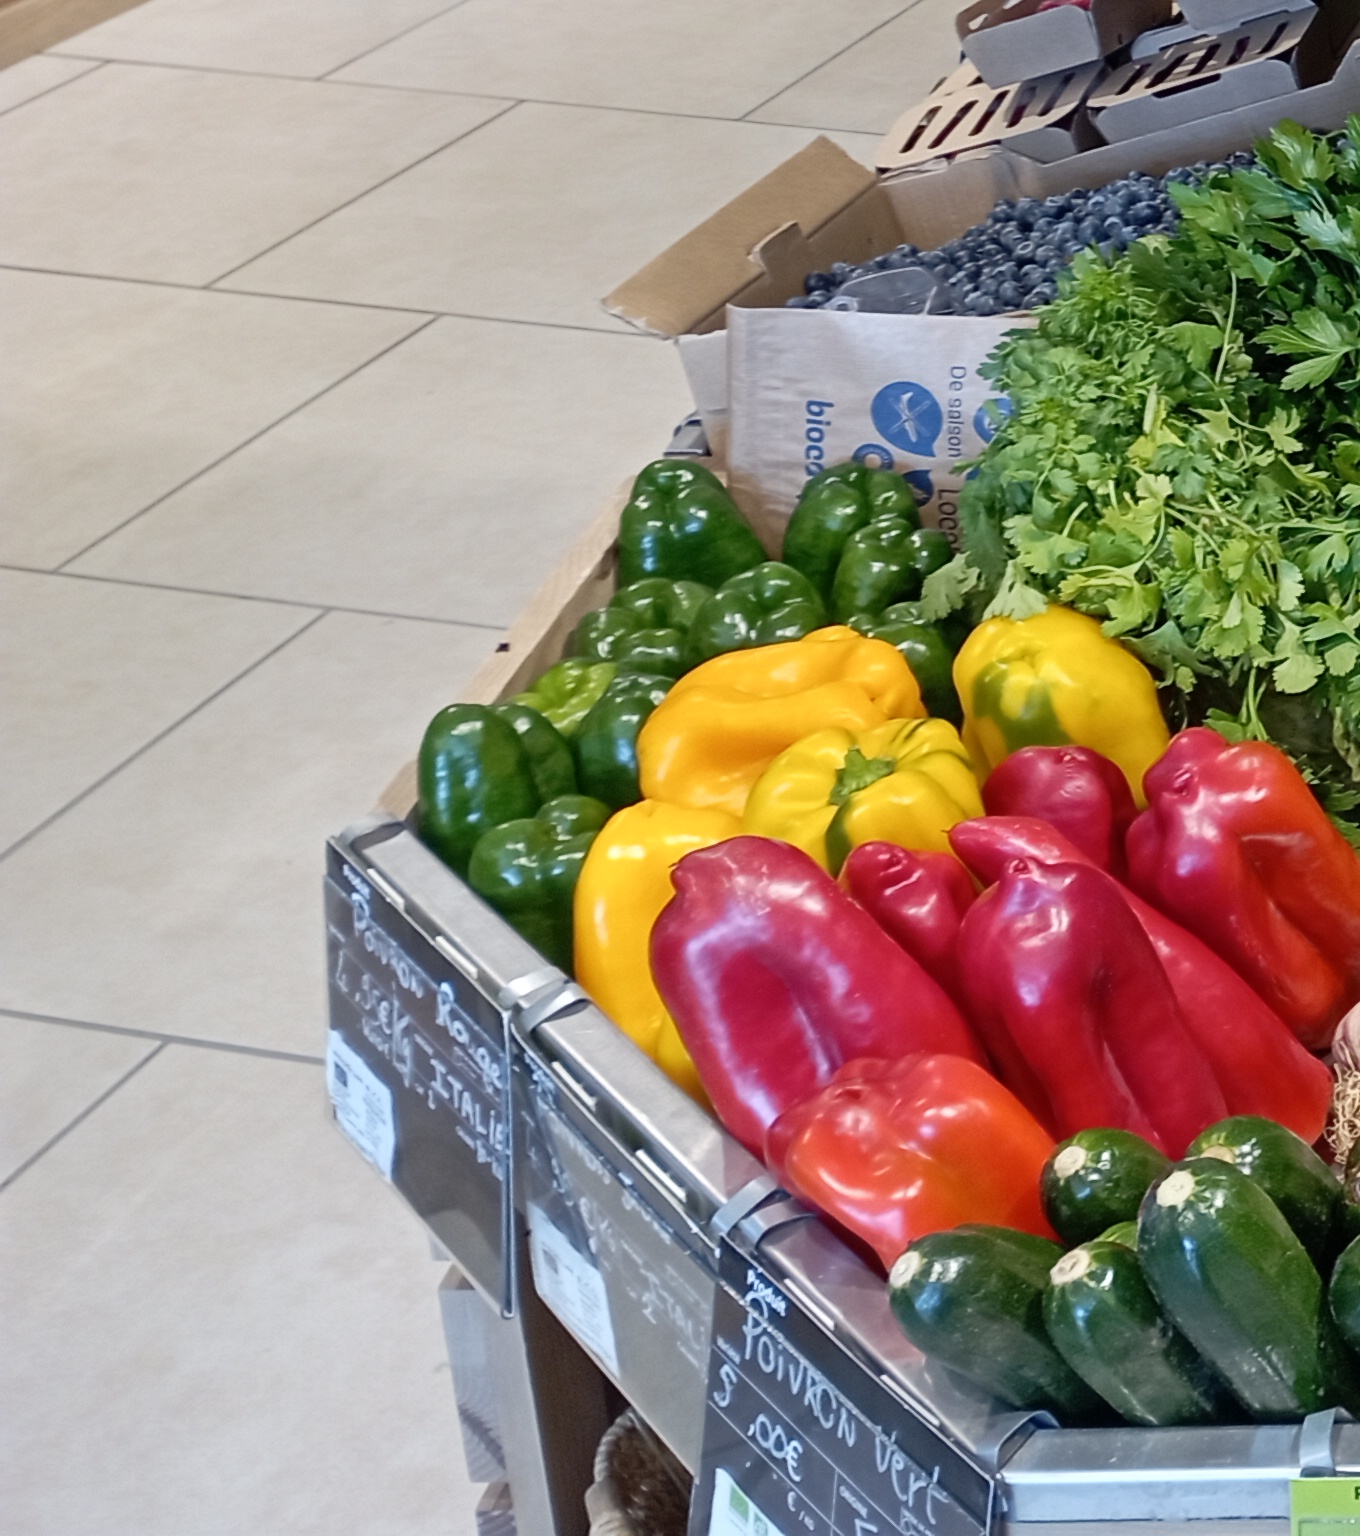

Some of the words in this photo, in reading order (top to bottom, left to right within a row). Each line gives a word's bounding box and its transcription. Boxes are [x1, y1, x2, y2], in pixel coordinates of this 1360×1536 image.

[950, 366, 967, 392] De
[948, 397, 965, 458] saison
[747, 1267, 786, 1317] Produit
